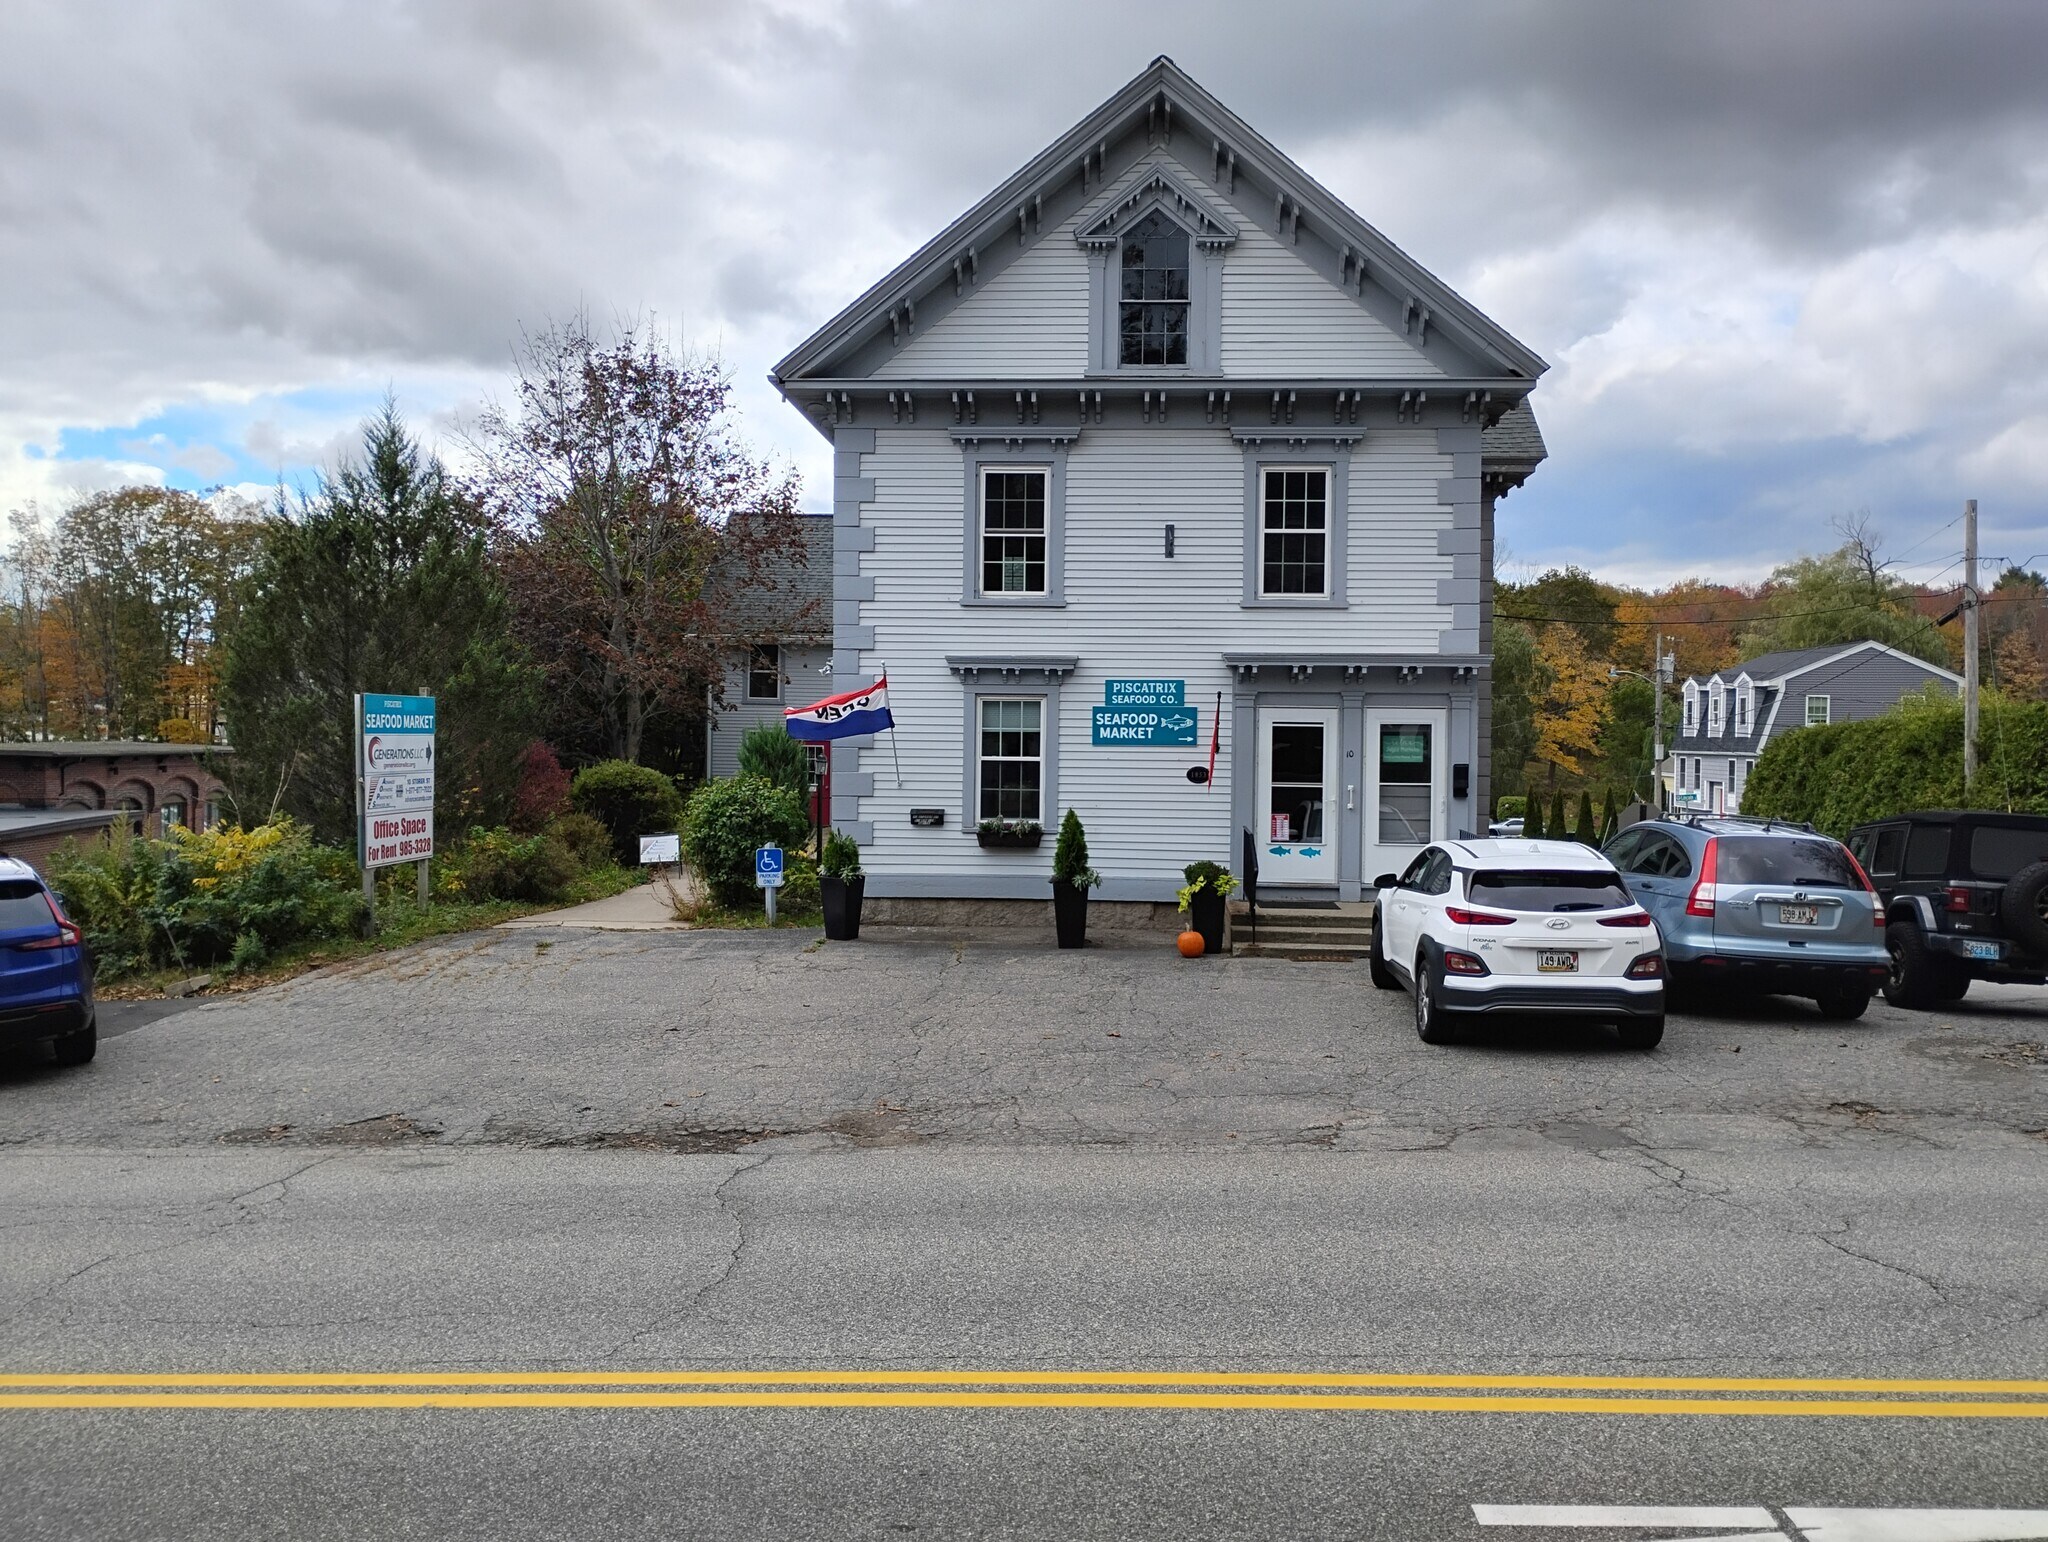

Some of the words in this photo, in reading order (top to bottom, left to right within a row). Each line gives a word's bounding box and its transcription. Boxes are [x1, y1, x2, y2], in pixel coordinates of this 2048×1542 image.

[1113, 682, 1177, 693] PISCATRIX
[1111, 695, 1156, 704] SEAFOOD
[1160, 695, 1178, 704] CO.
[366, 713, 402, 729] SEAFOOD
[403, 714, 434, 729] MARKET
[1096, 713, 1158, 725] SEAFOOD
[1100, 727, 1154, 739] MARKET
[1346, 749, 1354, 758] 10
[374, 820, 399, 840] Office
[401, 817, 427, 837] Space
[368, 846, 379, 861] For
[381, 843, 397, 860] Rent
[400, 837, 431, 857] 985-3328
